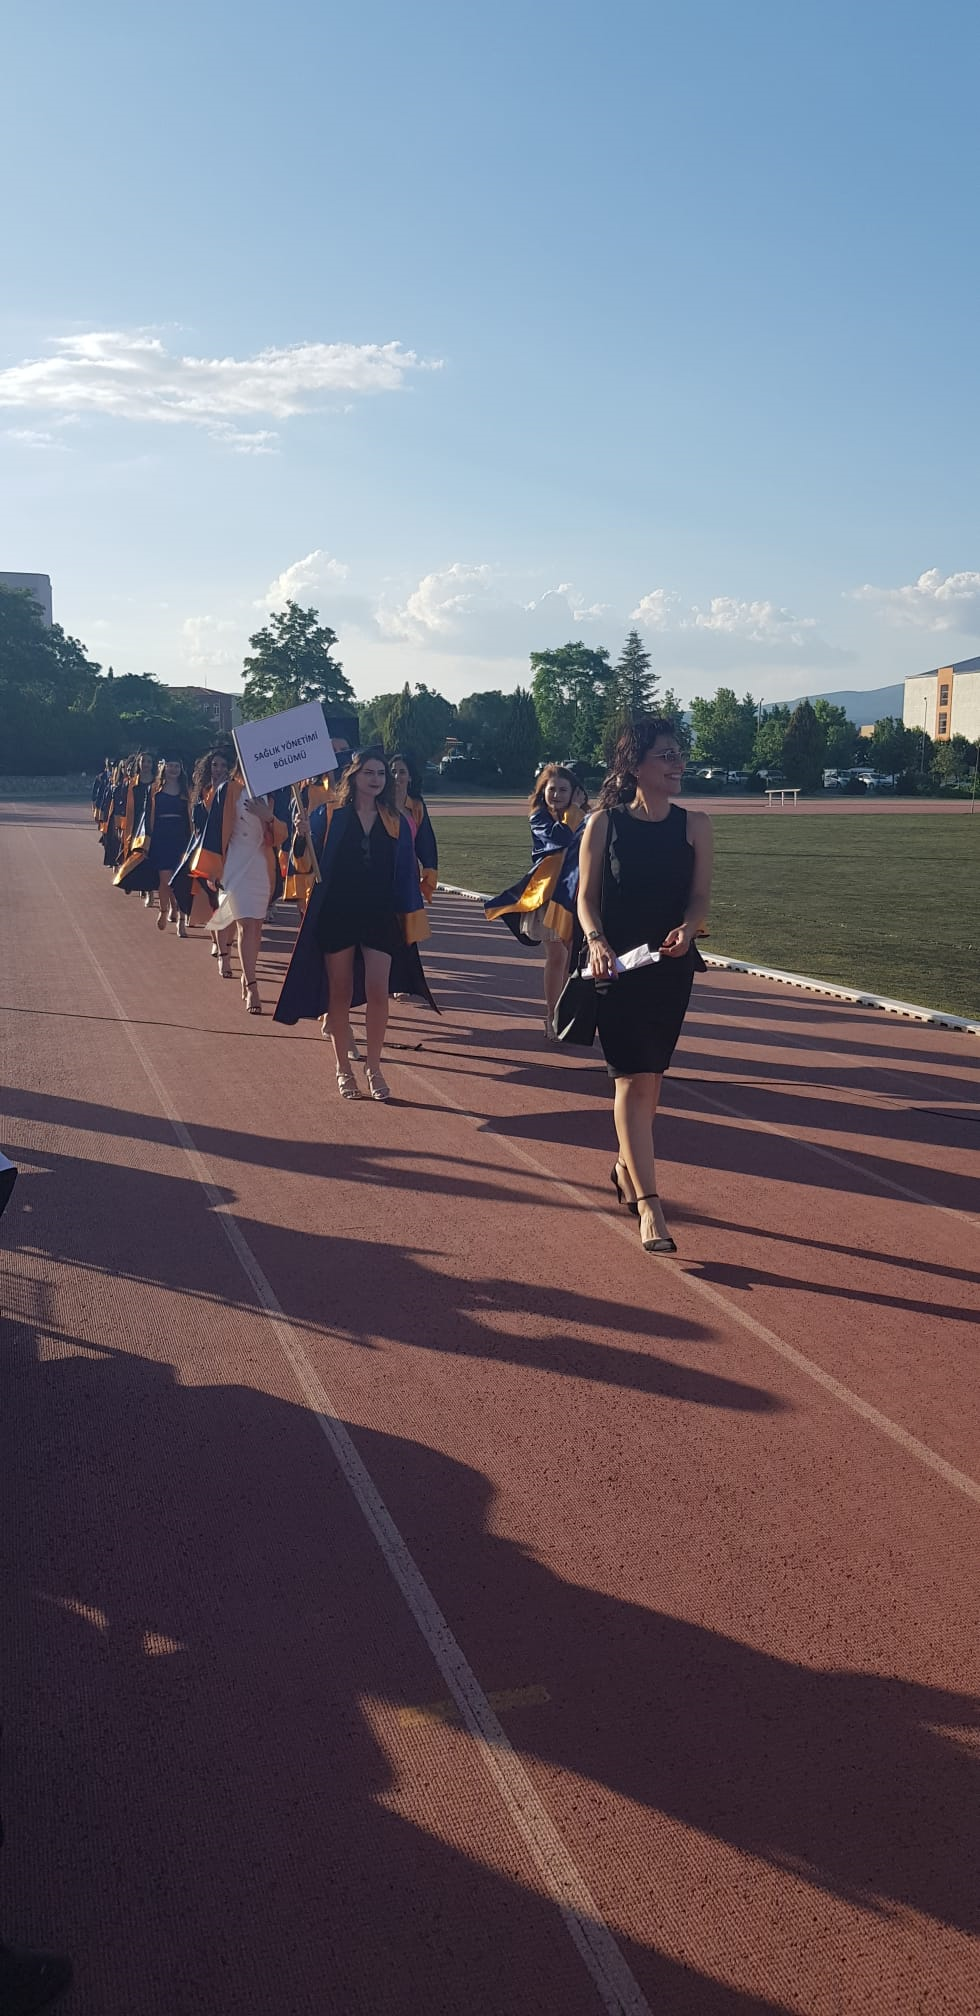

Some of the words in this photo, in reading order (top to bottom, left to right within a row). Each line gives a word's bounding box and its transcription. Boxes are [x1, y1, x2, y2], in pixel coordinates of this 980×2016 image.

[254, 746, 281, 762] SAĞLIK
[281, 731, 319, 751] YÖNETİMİ
[273, 750, 307, 769] BÖLÜMÜ
